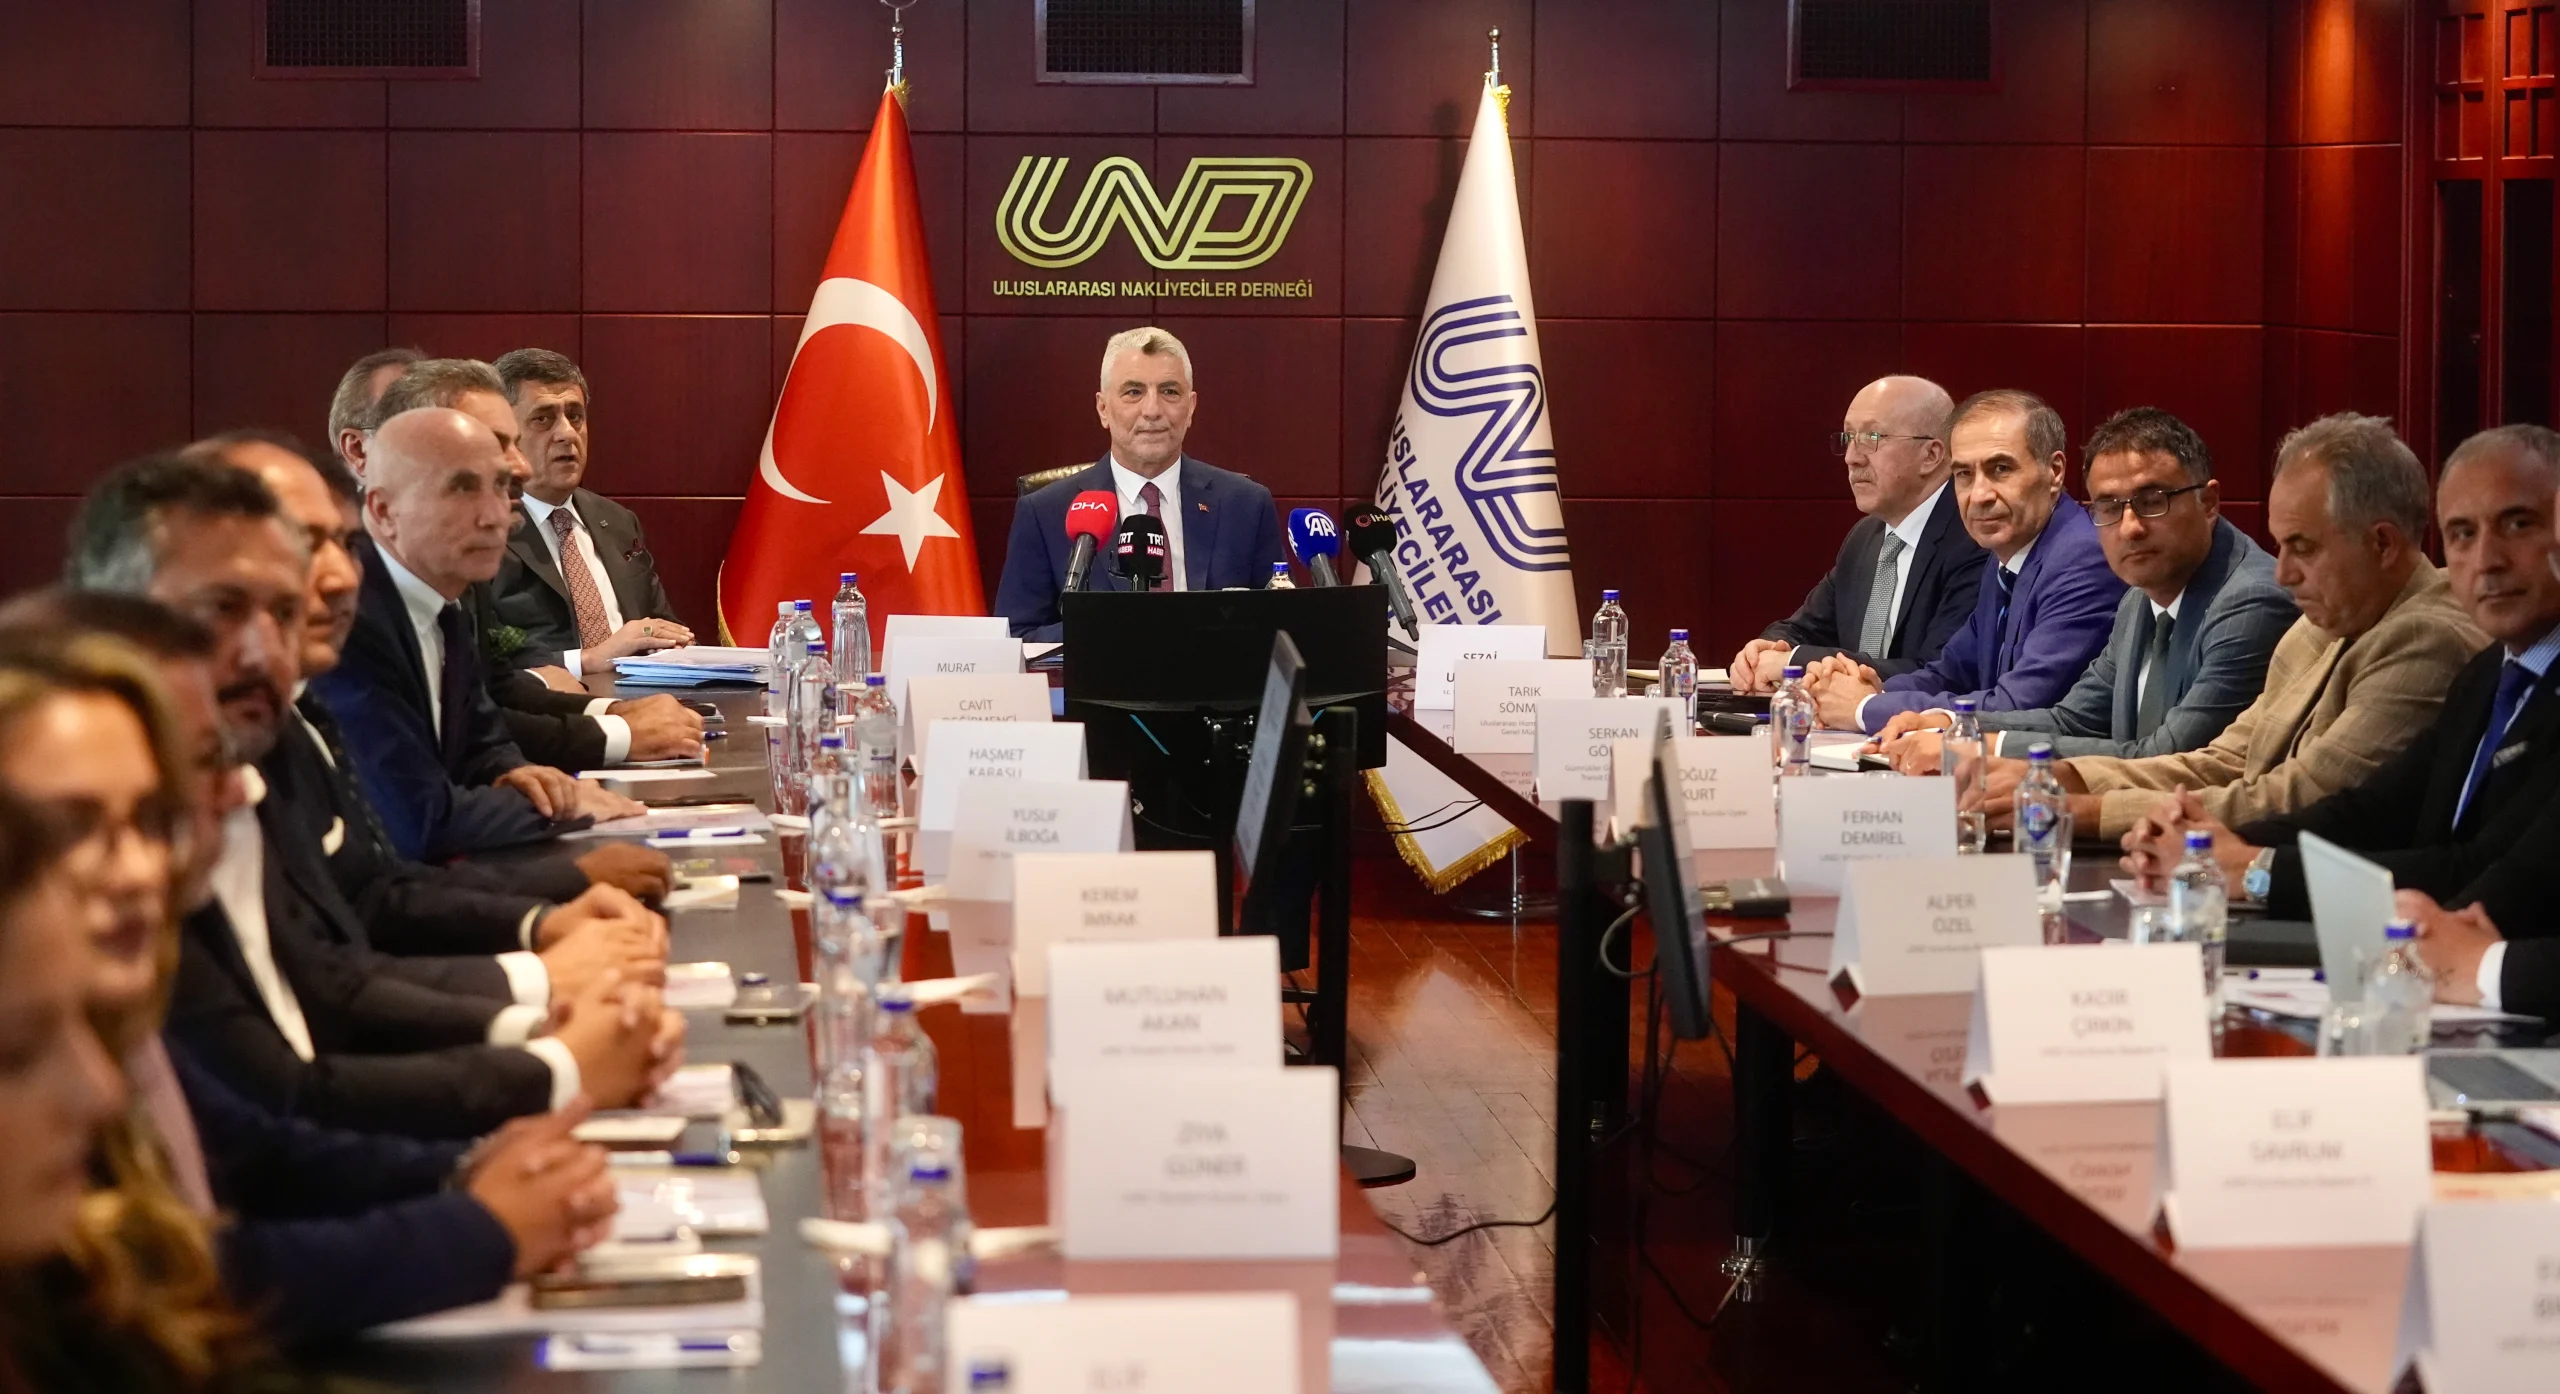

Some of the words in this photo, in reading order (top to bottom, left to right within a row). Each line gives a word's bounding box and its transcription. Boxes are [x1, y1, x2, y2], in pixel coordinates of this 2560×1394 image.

[996, 156, 1313, 269] UND
[993, 280, 1115, 297] ULUSLARARASI
[1121, 278, 1237, 297] NAKLİYECİLER
[1241, 279, 1313, 298] DERNEĞİ
[1071, 502, 1108, 512] DHA
[1391, 413, 1503, 625] USLARARASI
[1309, 517, 1337, 537] AA
[936, 662, 976, 673] MURAT
[1508, 686, 1541, 697] TARIK
[959, 698, 993, 711] CAVİT
[1499, 700, 1536, 713] SÖNM
[1588, 727, 1639, 739] SERKAN
[969, 747, 1025, 763] HAŞMET
[1012, 808, 1060, 823] YUSUF
[1842, 809, 1904, 825] FERHAN
[1841, 828, 1906, 846] DEMİREL
